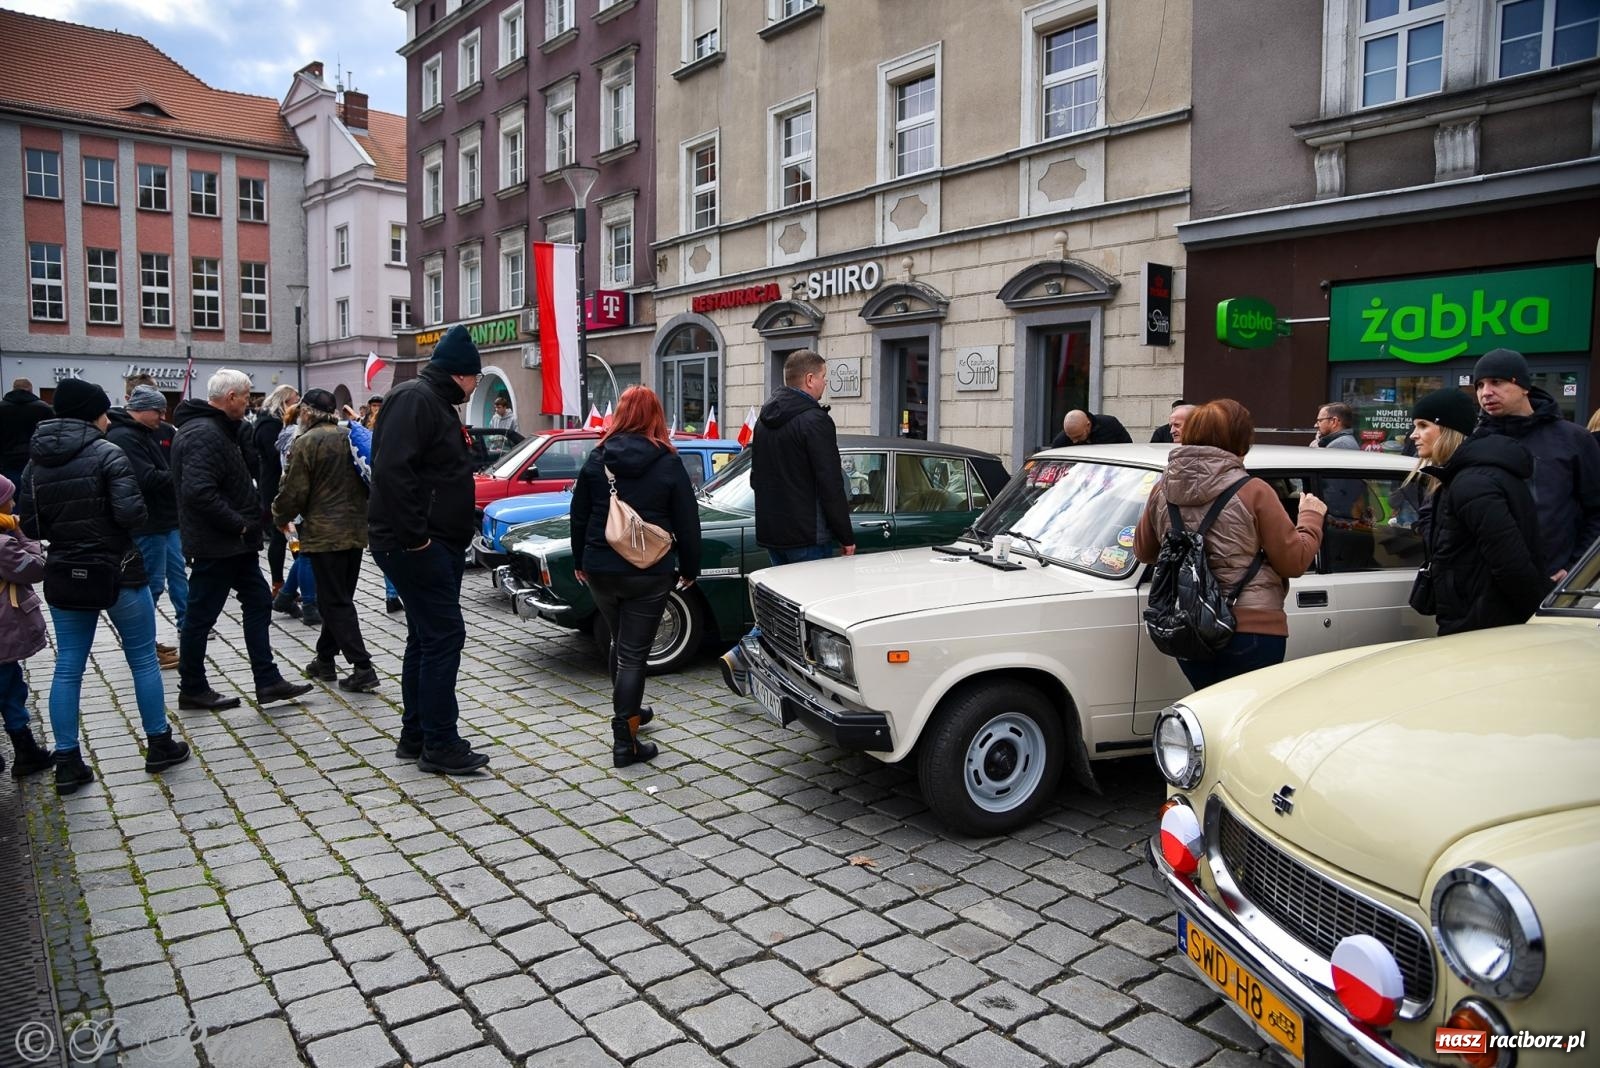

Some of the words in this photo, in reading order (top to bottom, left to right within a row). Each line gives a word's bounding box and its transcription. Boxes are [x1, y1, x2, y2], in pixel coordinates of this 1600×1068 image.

[603, 295, 620, 319] T
[692, 283, 781, 313] RESTAURACJA
[808, 261, 882, 300] SHIRO
[1232, 308, 1273, 331] żabka
[1360, 289, 1550, 343] żabka
[1191, 929, 1228, 987] SWD
[1236, 967, 1263, 1020] H8
